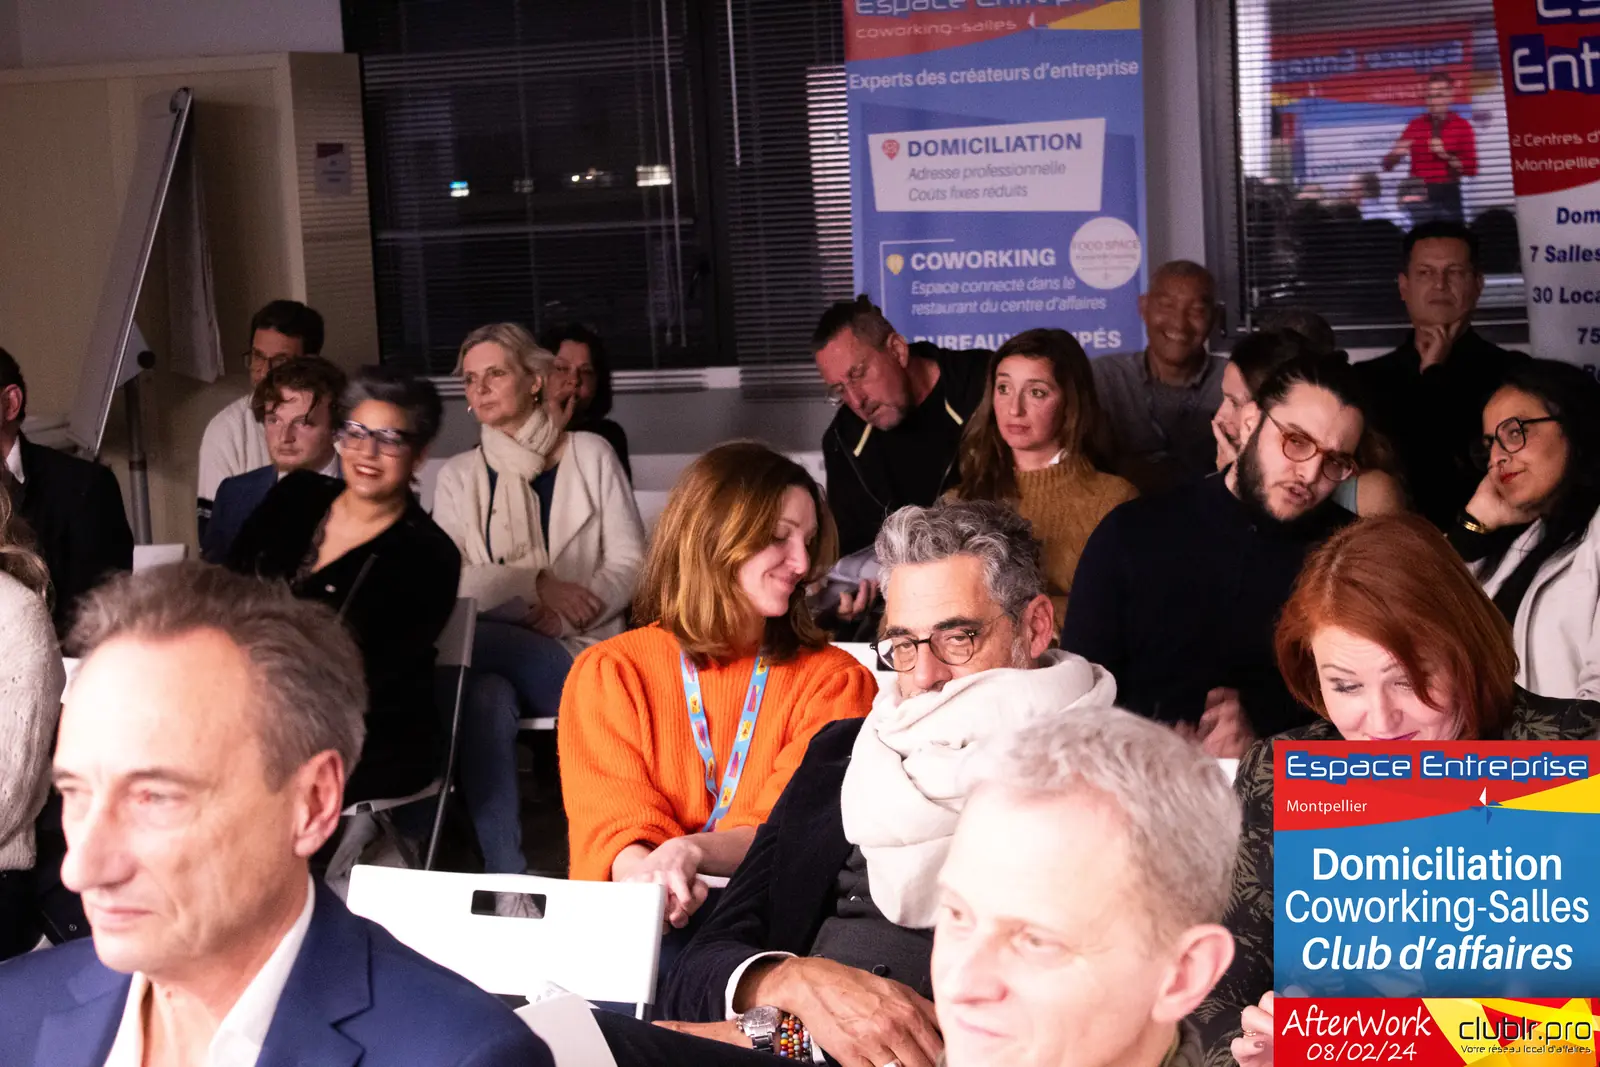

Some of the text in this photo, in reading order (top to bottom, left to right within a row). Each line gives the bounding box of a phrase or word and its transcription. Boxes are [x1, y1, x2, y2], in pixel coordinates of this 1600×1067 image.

[850, 59, 1139, 93] Experts des créateurs d'entreprise
[908, 132, 1083, 157] DOMICILIATION
[1524, 132, 1583, 147] Centres
[908, 160, 1066, 181] Adresse professionnelle
[951, 184, 980, 199] fixes
[911, 248, 1057, 271] COWORKING
[1530, 246, 1539, 262] 7
[911, 275, 1076, 297] Espace connecté dans le
[1533, 287, 1553, 304] 30
[911, 295, 1107, 316] restaurant du centre d'affaires
